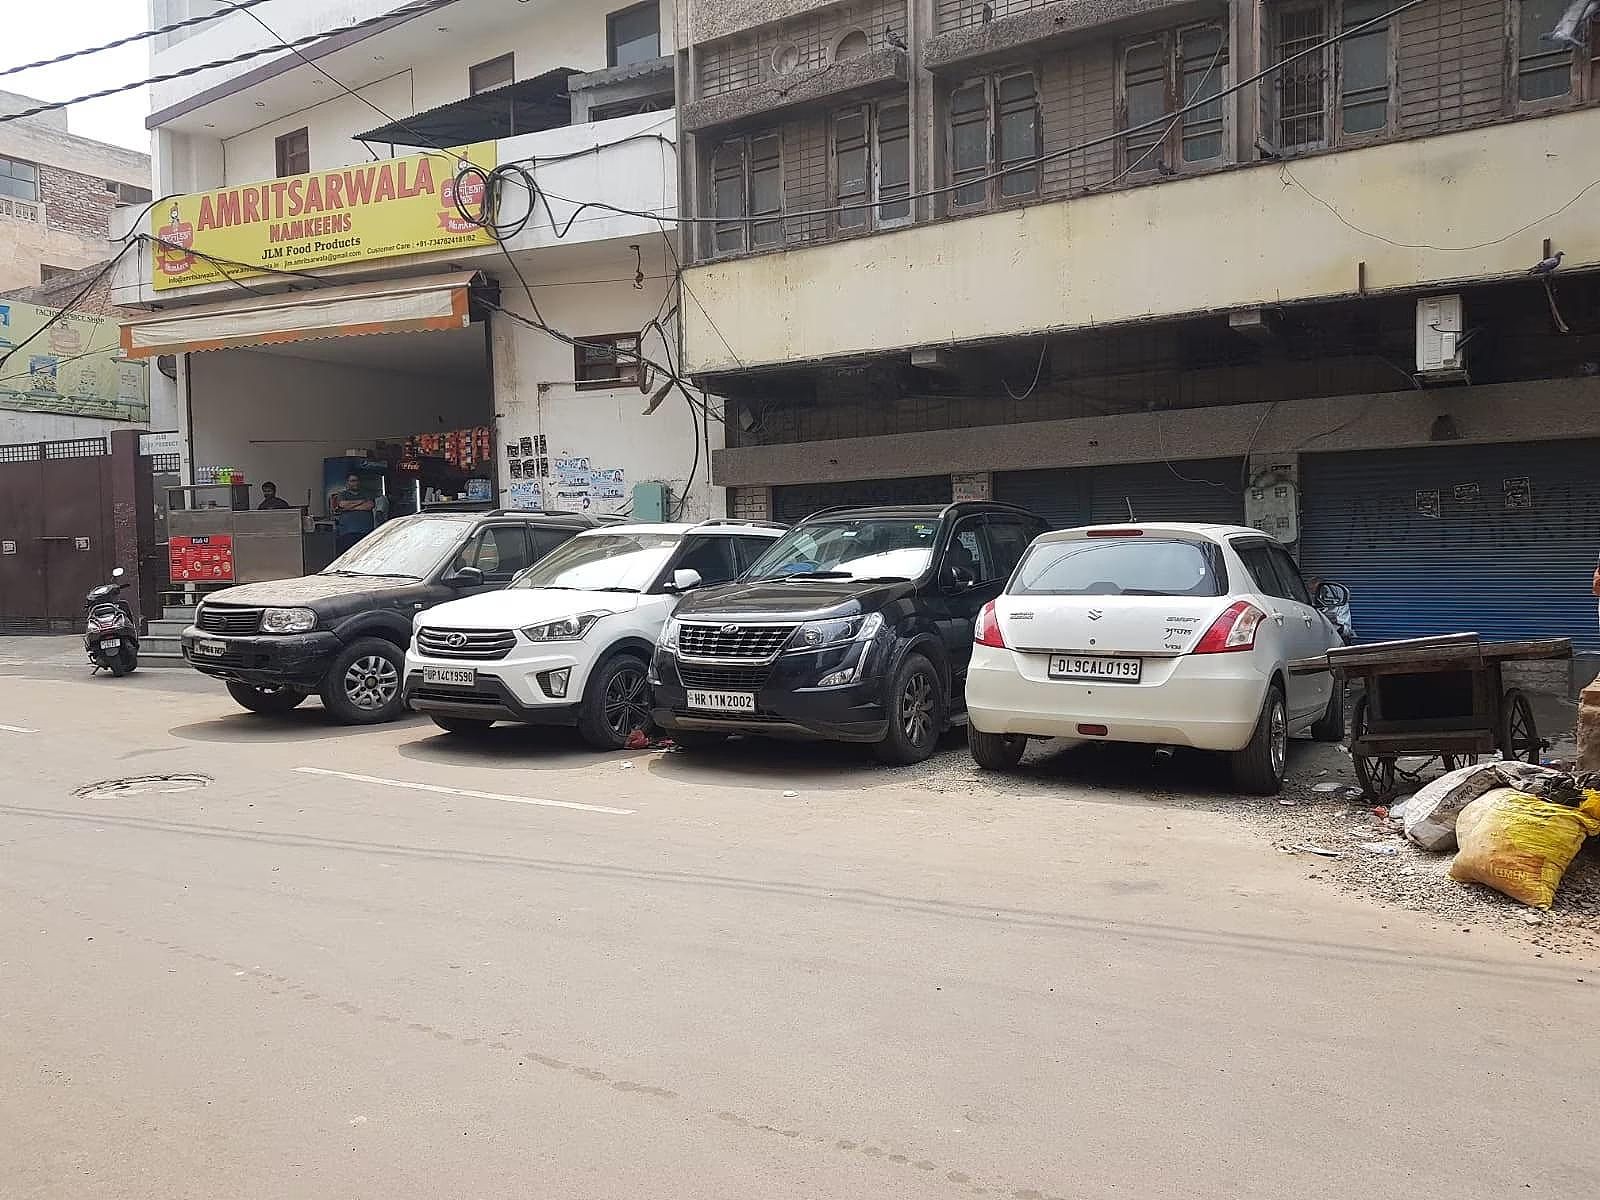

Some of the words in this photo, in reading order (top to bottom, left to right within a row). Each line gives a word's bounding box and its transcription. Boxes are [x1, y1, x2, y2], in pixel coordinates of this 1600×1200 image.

[197, 158, 435, 231] AMRITSARWALA
[269, 212, 352, 243] NAMKEENS
[261, 247, 283, 260] JLM
[286, 242, 311, 256] Food
[314, 236, 361, 252] Products
[1058, 659, 1138, 676] DL9CAL0193
